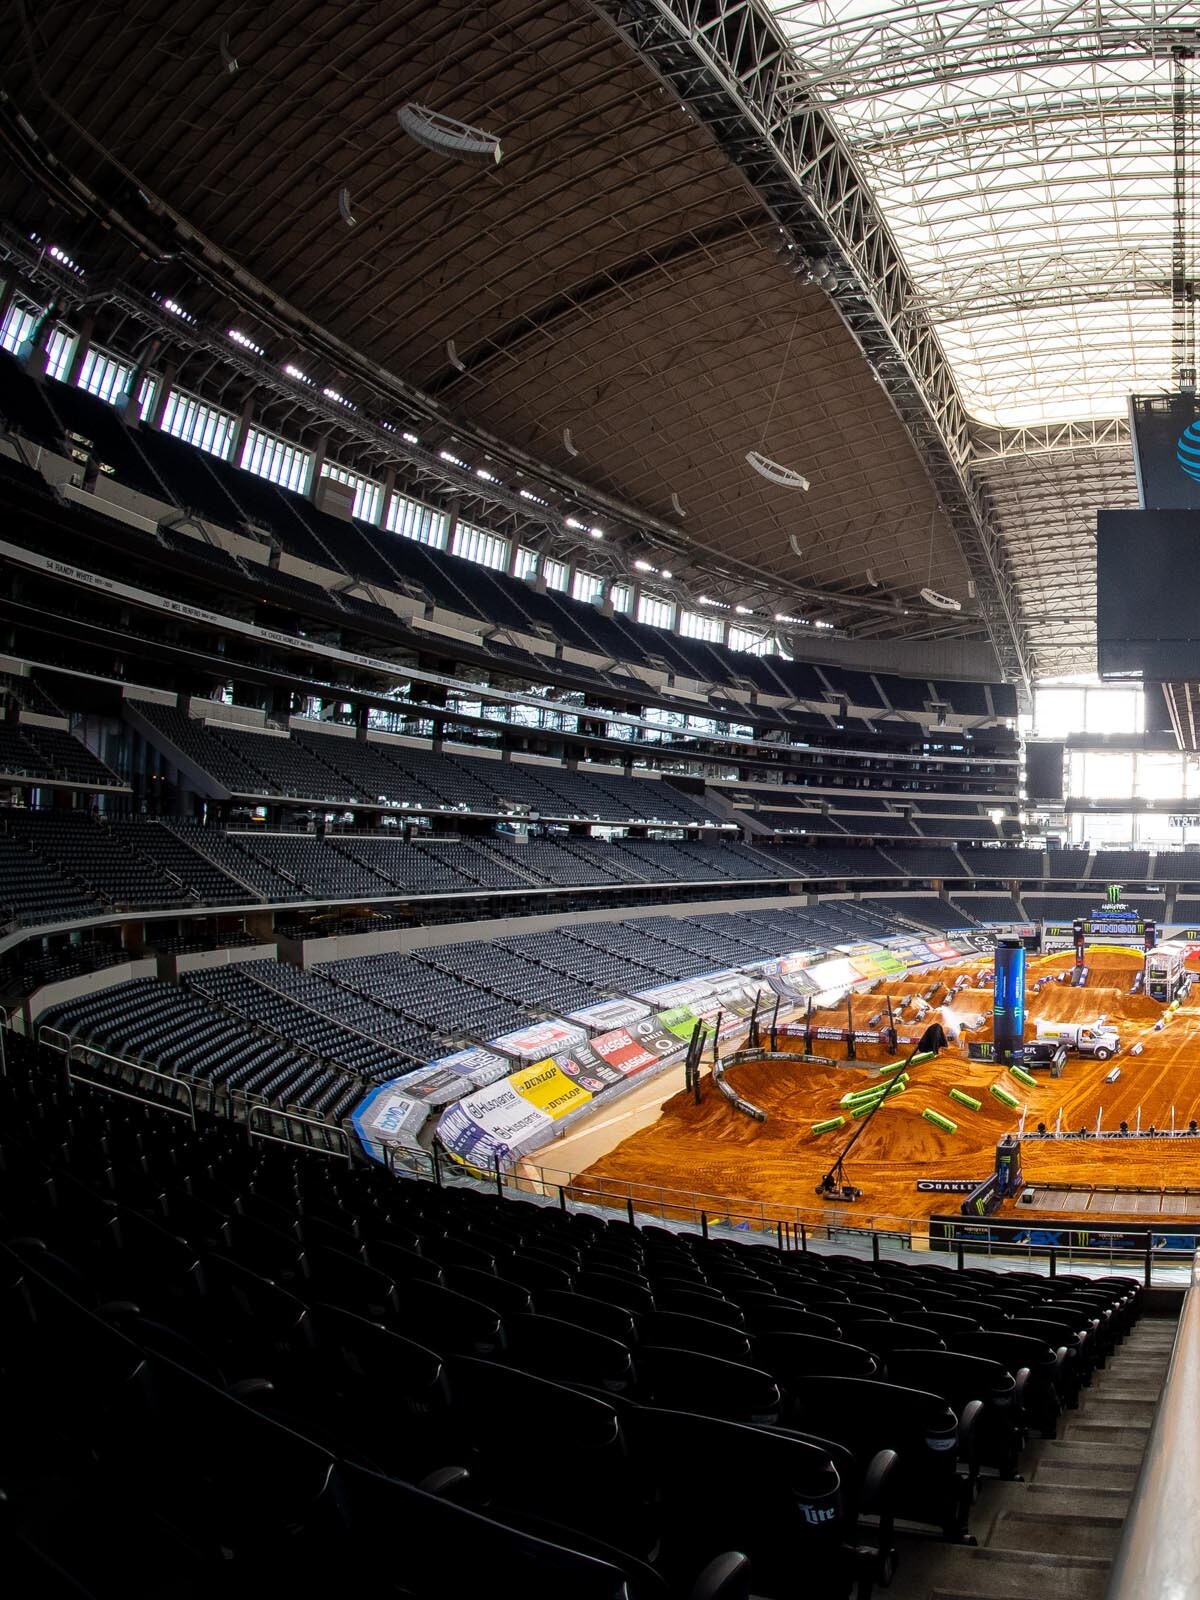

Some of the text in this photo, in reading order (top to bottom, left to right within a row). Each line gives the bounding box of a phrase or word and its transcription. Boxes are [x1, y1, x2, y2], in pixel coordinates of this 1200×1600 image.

[55, 563, 74, 577] RANDY
[75, 570, 94, 584] WHITE
[1169, 816, 1197, 827] AT&T
[1091, 923, 1136, 933] FINISH
[600, 1035, 633, 1055] GASGAS
[618, 1052, 653, 1072] GASGAS
[524, 1067, 557, 1089] DUNLOP
[478, 1091, 516, 1114] Husqvarna
[548, 1088, 581, 1109] DUNLOP
[503, 1112, 541, 1134] Husqvarna
[455, 1126, 477, 1151] RACING
[799, 1503, 835, 1525] Lite
